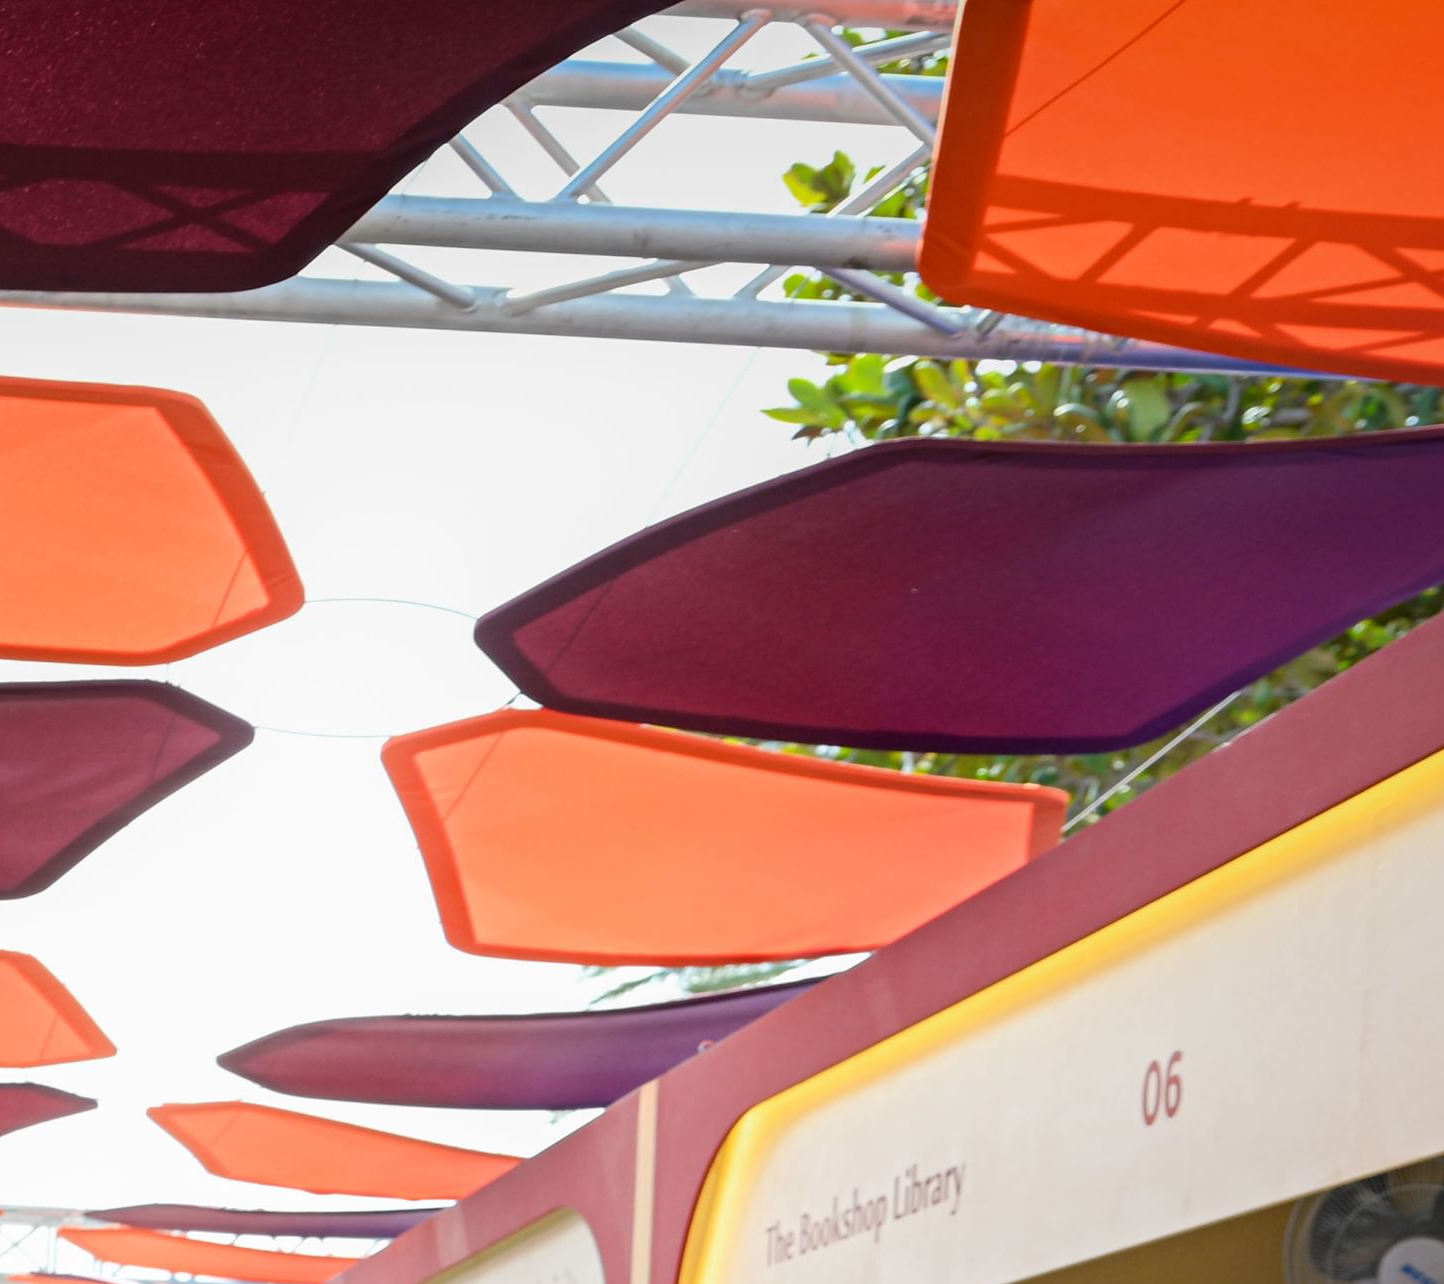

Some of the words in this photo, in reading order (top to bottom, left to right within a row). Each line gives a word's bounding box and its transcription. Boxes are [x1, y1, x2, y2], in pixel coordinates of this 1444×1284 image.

[1141, 1049, 1184, 1128] 06
[765, 1225, 795, 1268] The
[797, 1188, 889, 1256] Bookshop
[892, 1161, 968, 1221] Library
